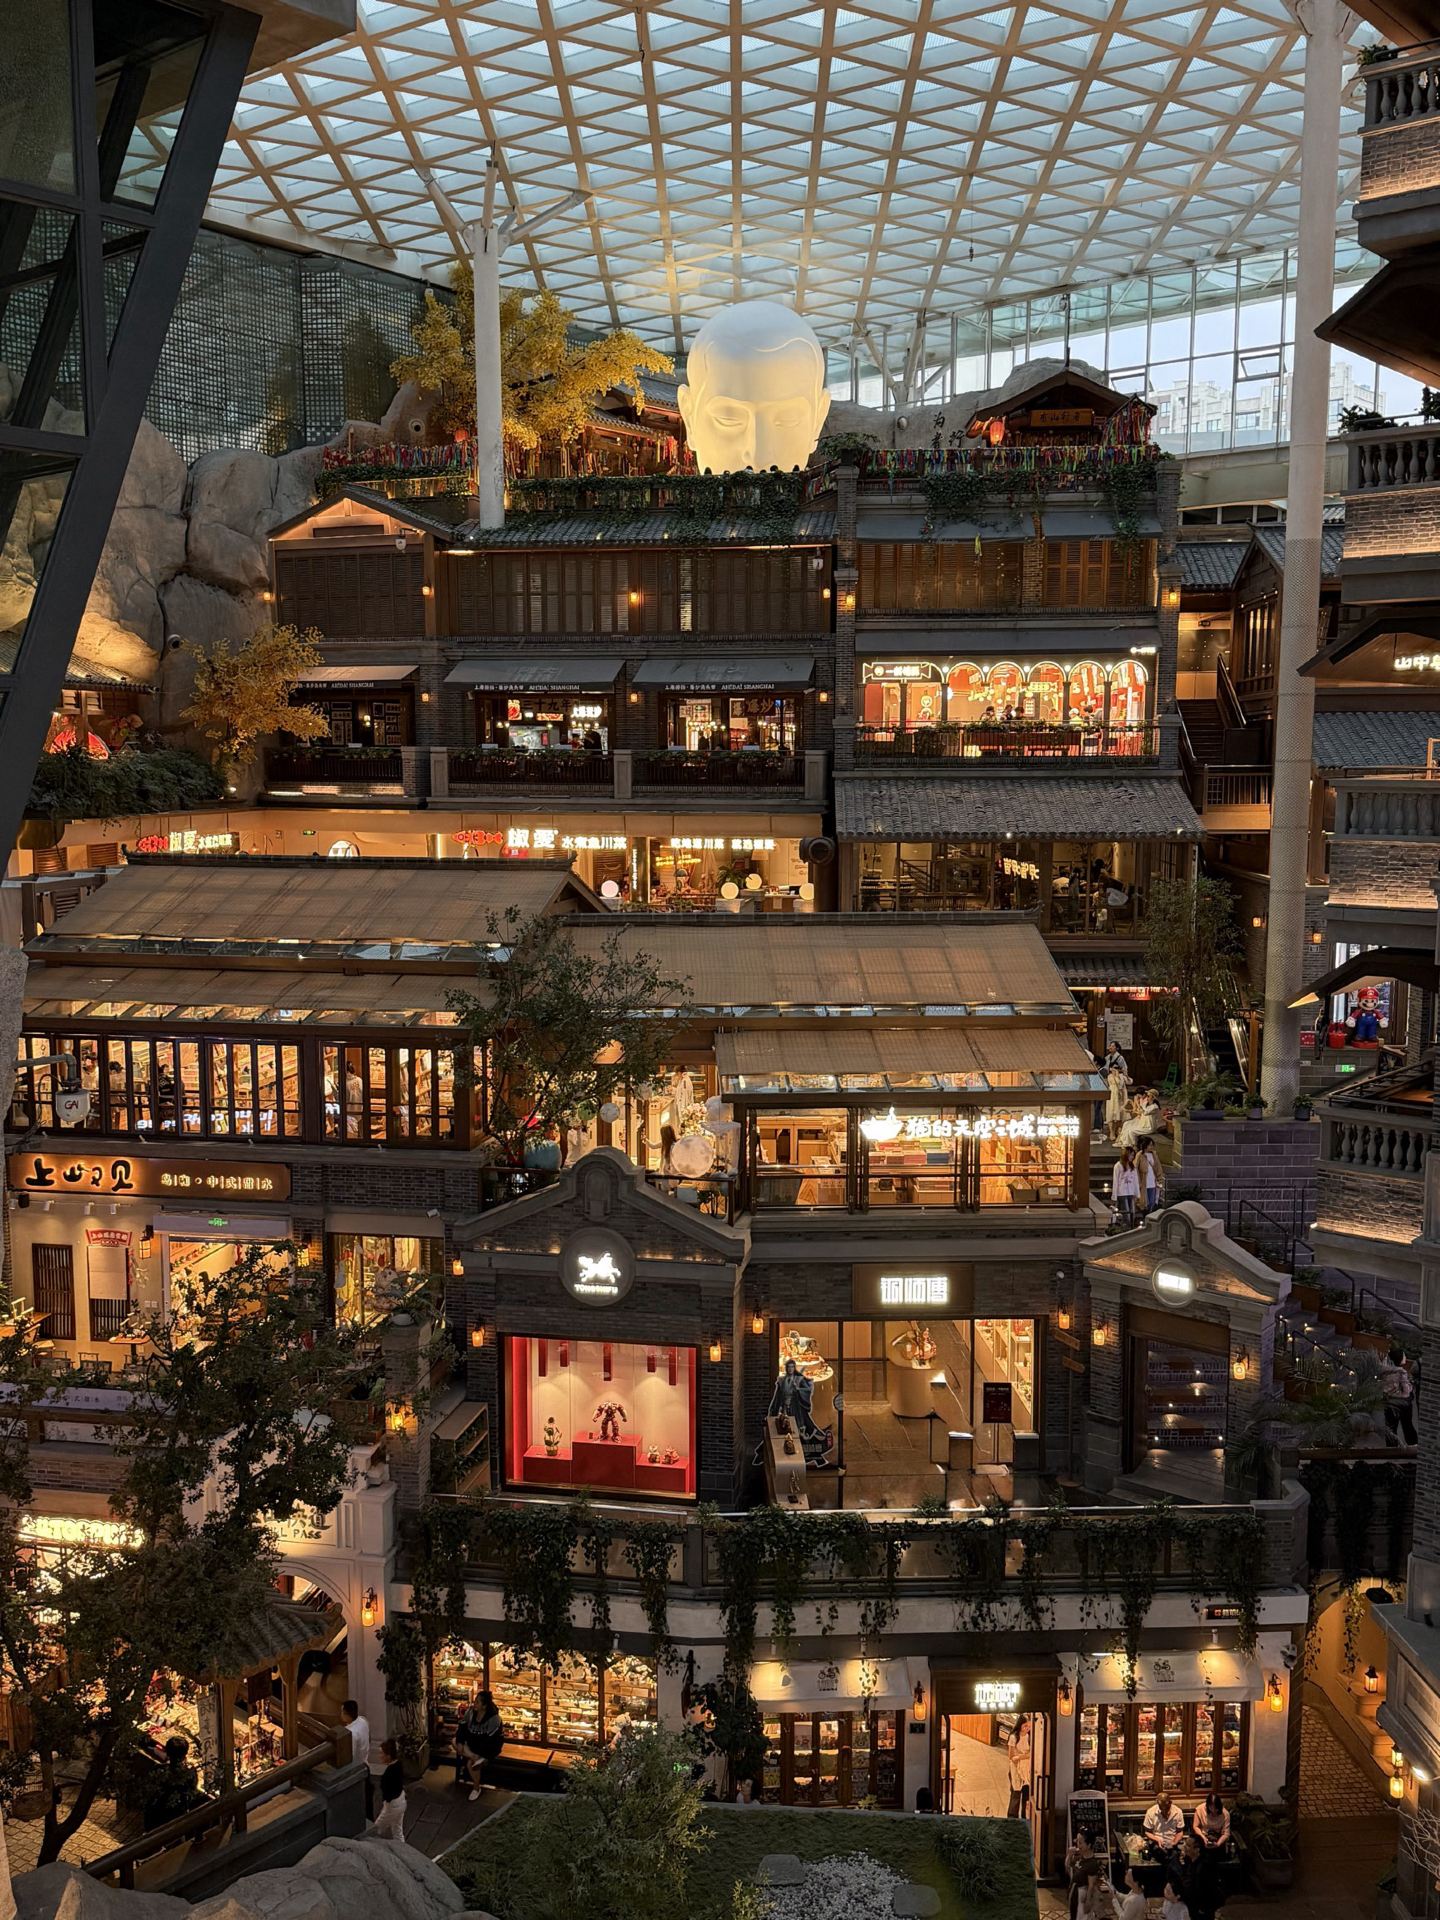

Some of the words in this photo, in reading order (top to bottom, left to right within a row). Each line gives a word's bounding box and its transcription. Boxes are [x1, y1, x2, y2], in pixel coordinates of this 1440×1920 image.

[906, 1114, 1037, 1140] 猫的天空之城
[293, 1528, 322, 1540] PASS
